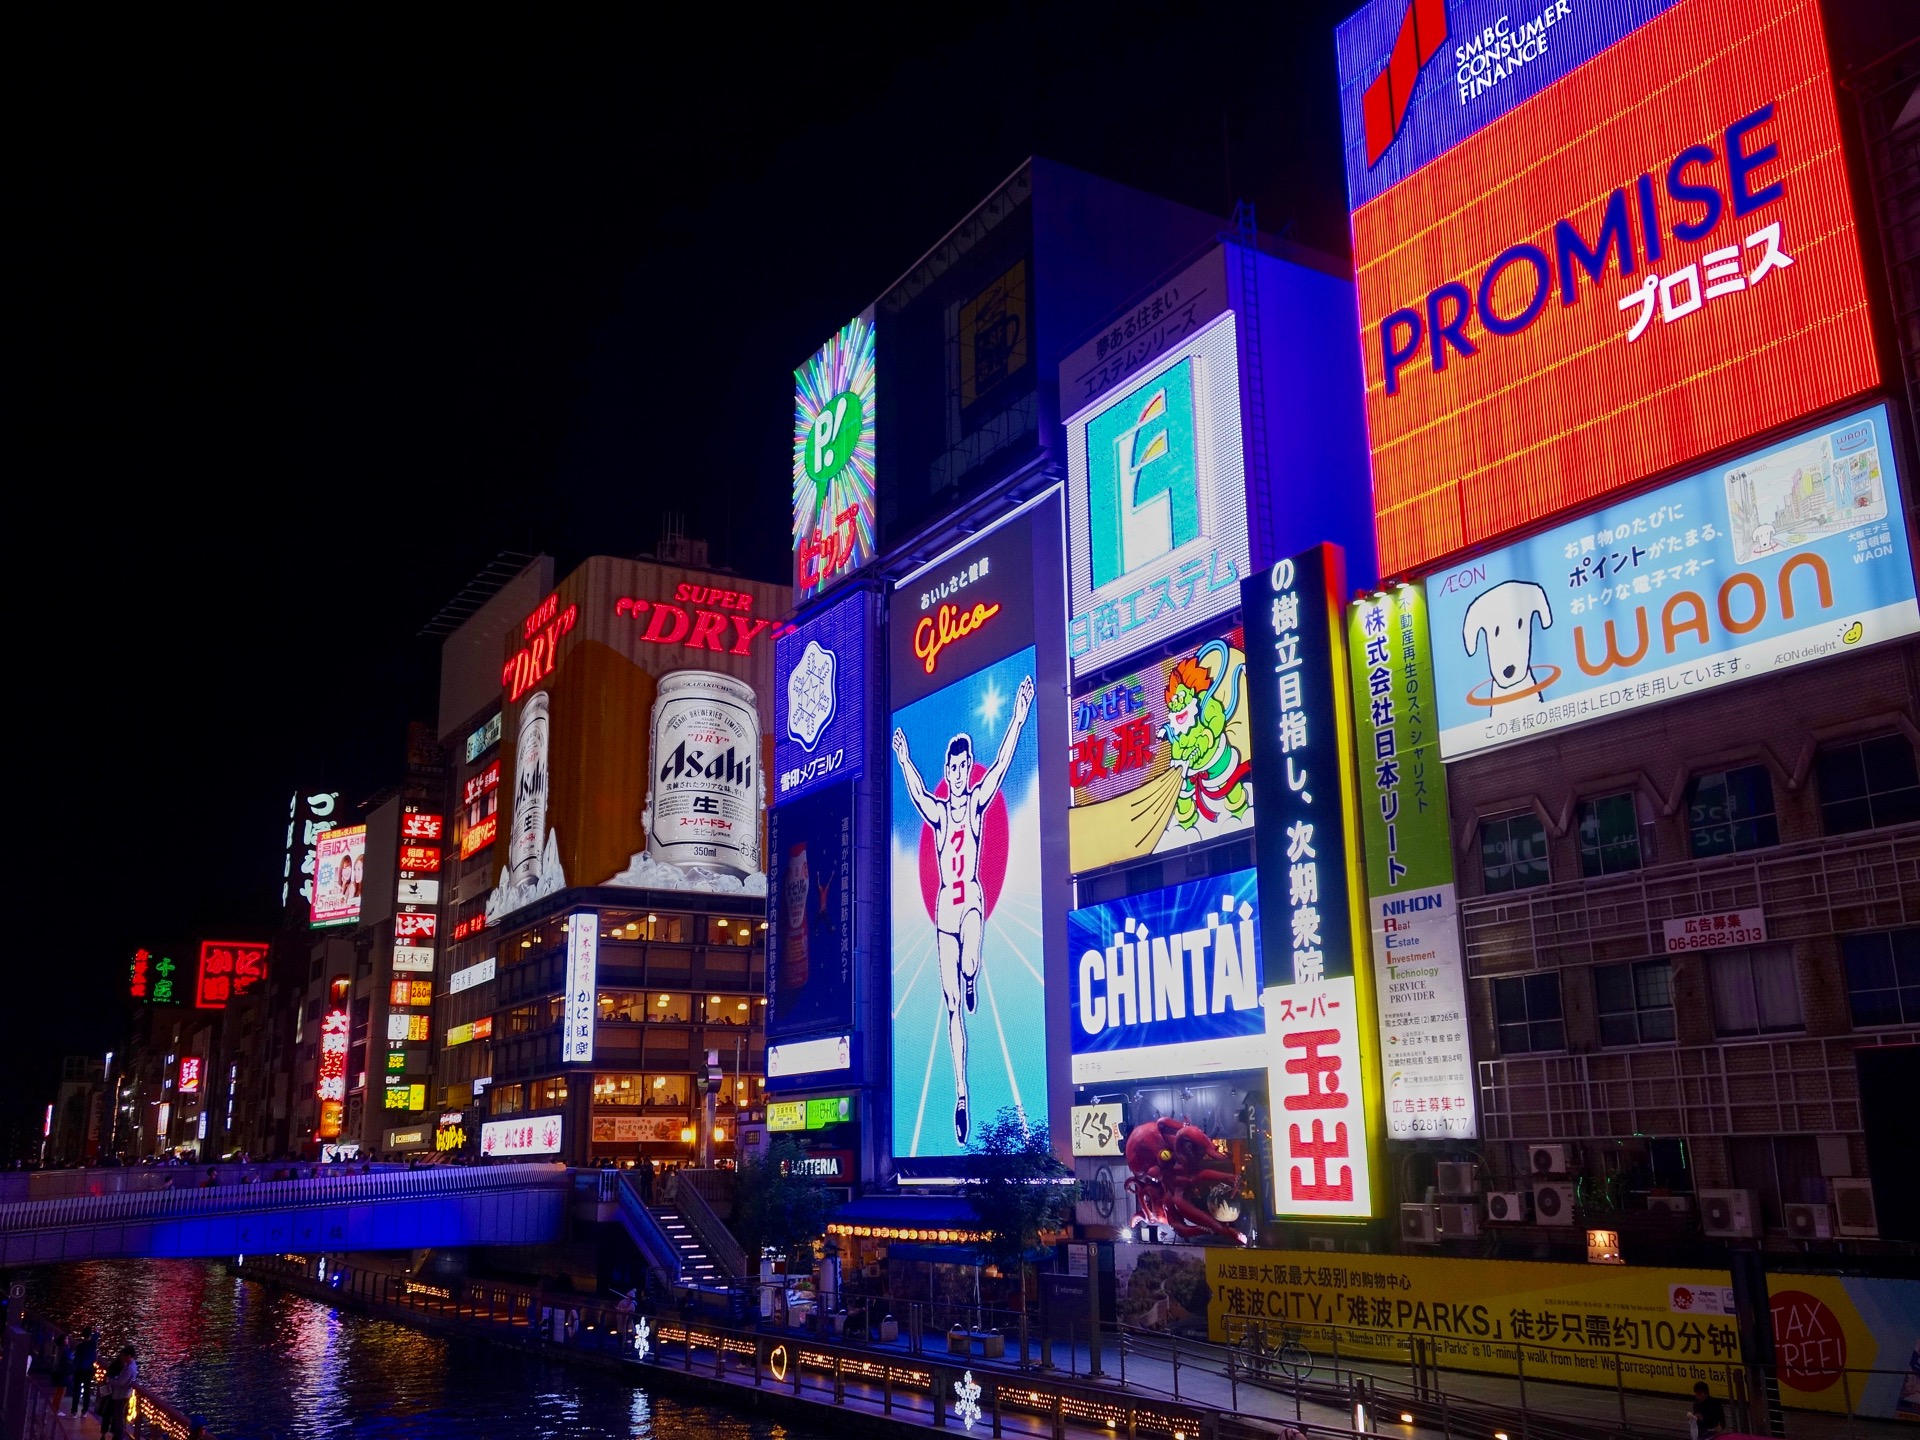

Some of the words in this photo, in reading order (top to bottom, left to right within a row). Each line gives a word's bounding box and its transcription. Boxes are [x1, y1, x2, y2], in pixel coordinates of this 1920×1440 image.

[1456, 16, 1510, 67] SMBC
[1457, 0, 1573, 85] CONSUMER
[1460, 34, 1549, 105] FINANCE
[1381, 103, 1785, 396] PROMISE
[1619, 222, 1794, 342] プロミス
[1096, 287, 1180, 360] 夢ある住まい
[1084, 304, 1197, 400] エステムシリーズ
[1563, 503, 1684, 561] お買物のたびに
[1847, 523, 1890, 542] 大阪ミナミ
[1856, 532, 1892, 553] 道頓堀
[799, 503, 860, 590] ピップ
[1568, 525, 1725, 589] ポイントがたまる、
[1852, 545, 1893, 565] WAON
[921, 555, 990, 610] おいしさと健康
[1570, 558, 1716, 616] おトクな電子マネー
[675, 582, 754, 612] SUPER
[1069, 549, 1238, 658] 日商エステム
[524, 593, 558, 640] SUPER
[913, 599, 1000, 676] Glico
[1801, 640, 1837, 659] delight
[1075, 684, 1144, 732] かぜに
[1398, 597, 1429, 813] 不動産再生のスペシャリスト
[1484, 656, 1752, 740] この看板の照明はLEDを使用しています。
[672, 715, 688, 731] ASAHI
[689, 708, 723, 721] BREWERIES
[724, 717, 744, 739] LIMITED
[1069, 713, 1155, 789] 改源
[1365, 605, 1407, 886] 株式会社日本リート
[660, 739, 752, 790] Asahi
[780, 749, 844, 793] 雪印メグミルク
[405, 805, 419, 813] 8F
[692, 796, 720, 815] 生
[680, 817, 733, 831] スーパードライ
[321, 839, 351, 858] 高収入
[403, 838, 417, 846] 7F
[693, 846, 717, 857] 350ml
[400, 871, 415, 879] 6F
[949, 823, 967, 906] グリコ
[405, 905, 417, 913] 5F
[1382, 893, 1442, 917] NIHON
[1384, 917, 1411, 933] Real
[1684, 914, 1742, 934] 広告募集
[395, 938, 411, 946] 4F
[1385, 934, 1420, 949] Estate
[1668, 927, 1762, 951] 06-6262-1313
[395, 950, 430, 965] 白木屋
[1079, 900, 1258, 1036] CHINTAI
[1386, 950, 1436, 965] Investment
[393, 972, 408, 980] 3F
[1387, 965, 1439, 980] Technology
[411, 987, 431, 998] 280円
[1389, 980, 1427, 993] SERVICE
[1390, 991, 1435, 1004] PROVIDER
[1280, 995, 1340, 1022] スーパー
[575, 990, 591, 1056] かに道楽
[389, 1041, 403, 1049] 1F
[188, 1059, 199, 1079] ツルハ
[1282, 1028, 1354, 1202] 玉出
[1392, 1096, 1466, 1113] 広告主募集中
[1393, 1118, 1467, 1132] 06-6281-1717
[791, 1158, 839, 1175] LOTTERIA
[1588, 1232, 1619, 1248] BAR
[1769, 1302, 1826, 1341] TAX
[1527, 1350, 1548, 1363] walk
[1551, 1351, 1572, 1366] from
[1574, 1354, 1598, 1368] here!
[1602, 1354, 1616, 1370] We
[1677, 1364, 1687, 1378] to
[1689, 1365, 1706, 1379] the
